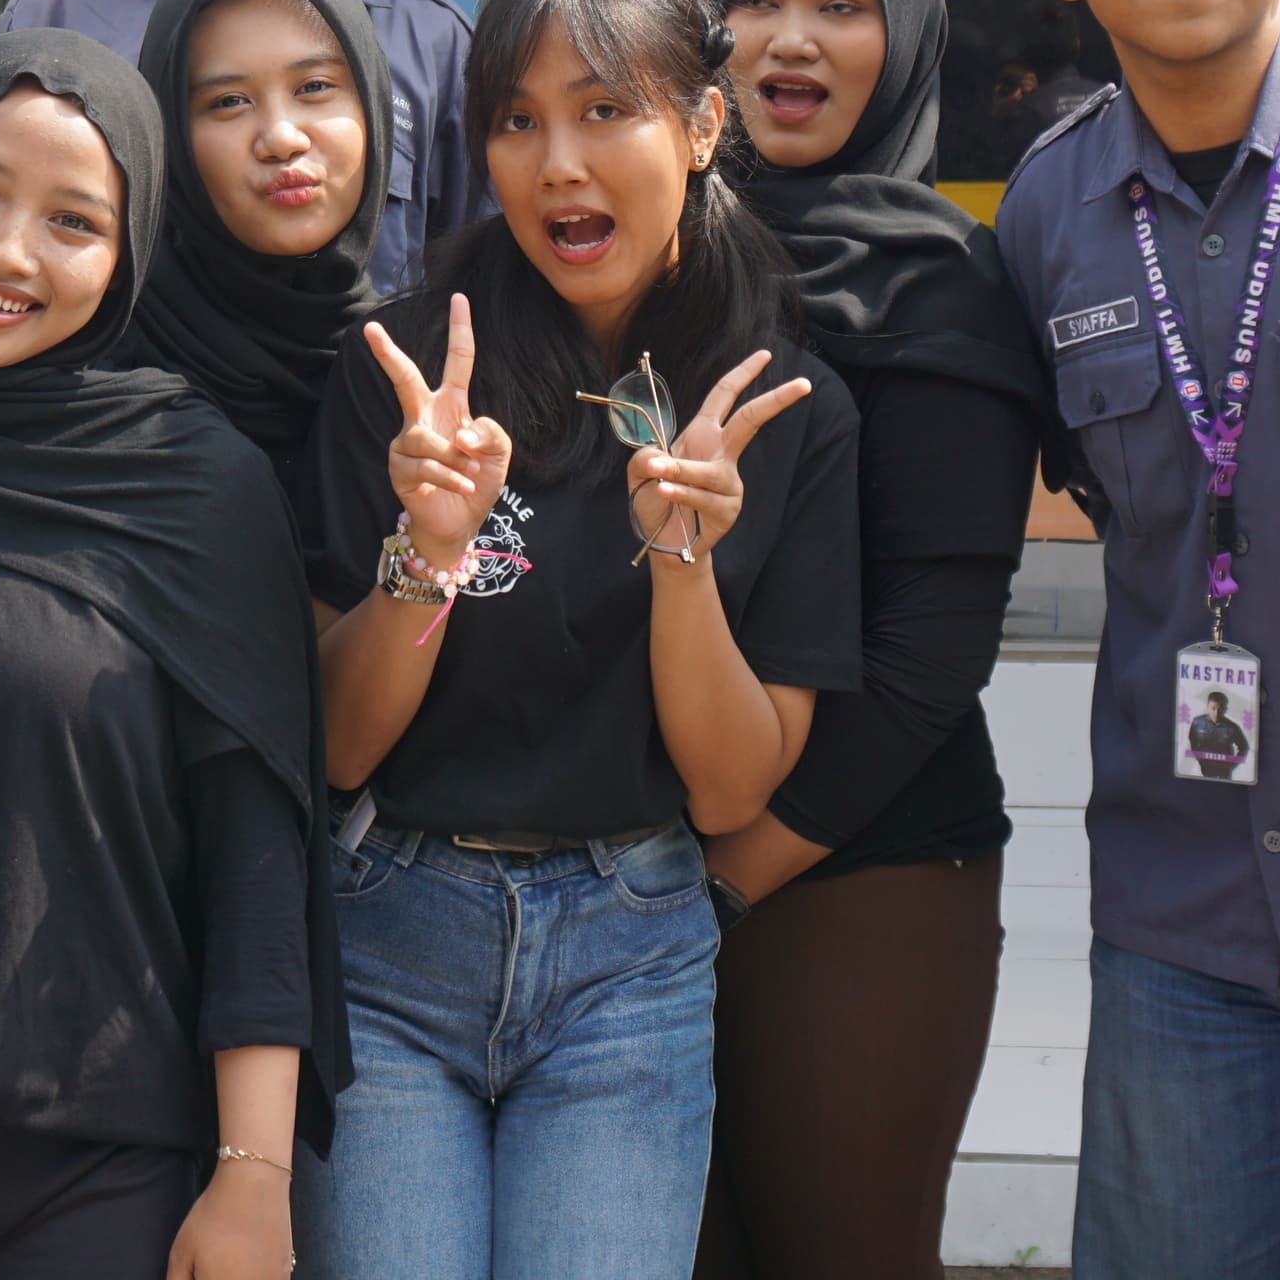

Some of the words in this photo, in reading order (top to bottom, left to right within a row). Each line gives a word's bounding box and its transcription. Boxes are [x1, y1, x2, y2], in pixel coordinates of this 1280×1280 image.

[1133, 206, 1167, 302] UDINUS
[1068, 308, 1118, 337] SYAFFA
[1159, 308, 1192, 374] HMTI
[1235, 260, 1270, 365] UDINUS
[1181, 663, 1257, 686] KASTRAT
